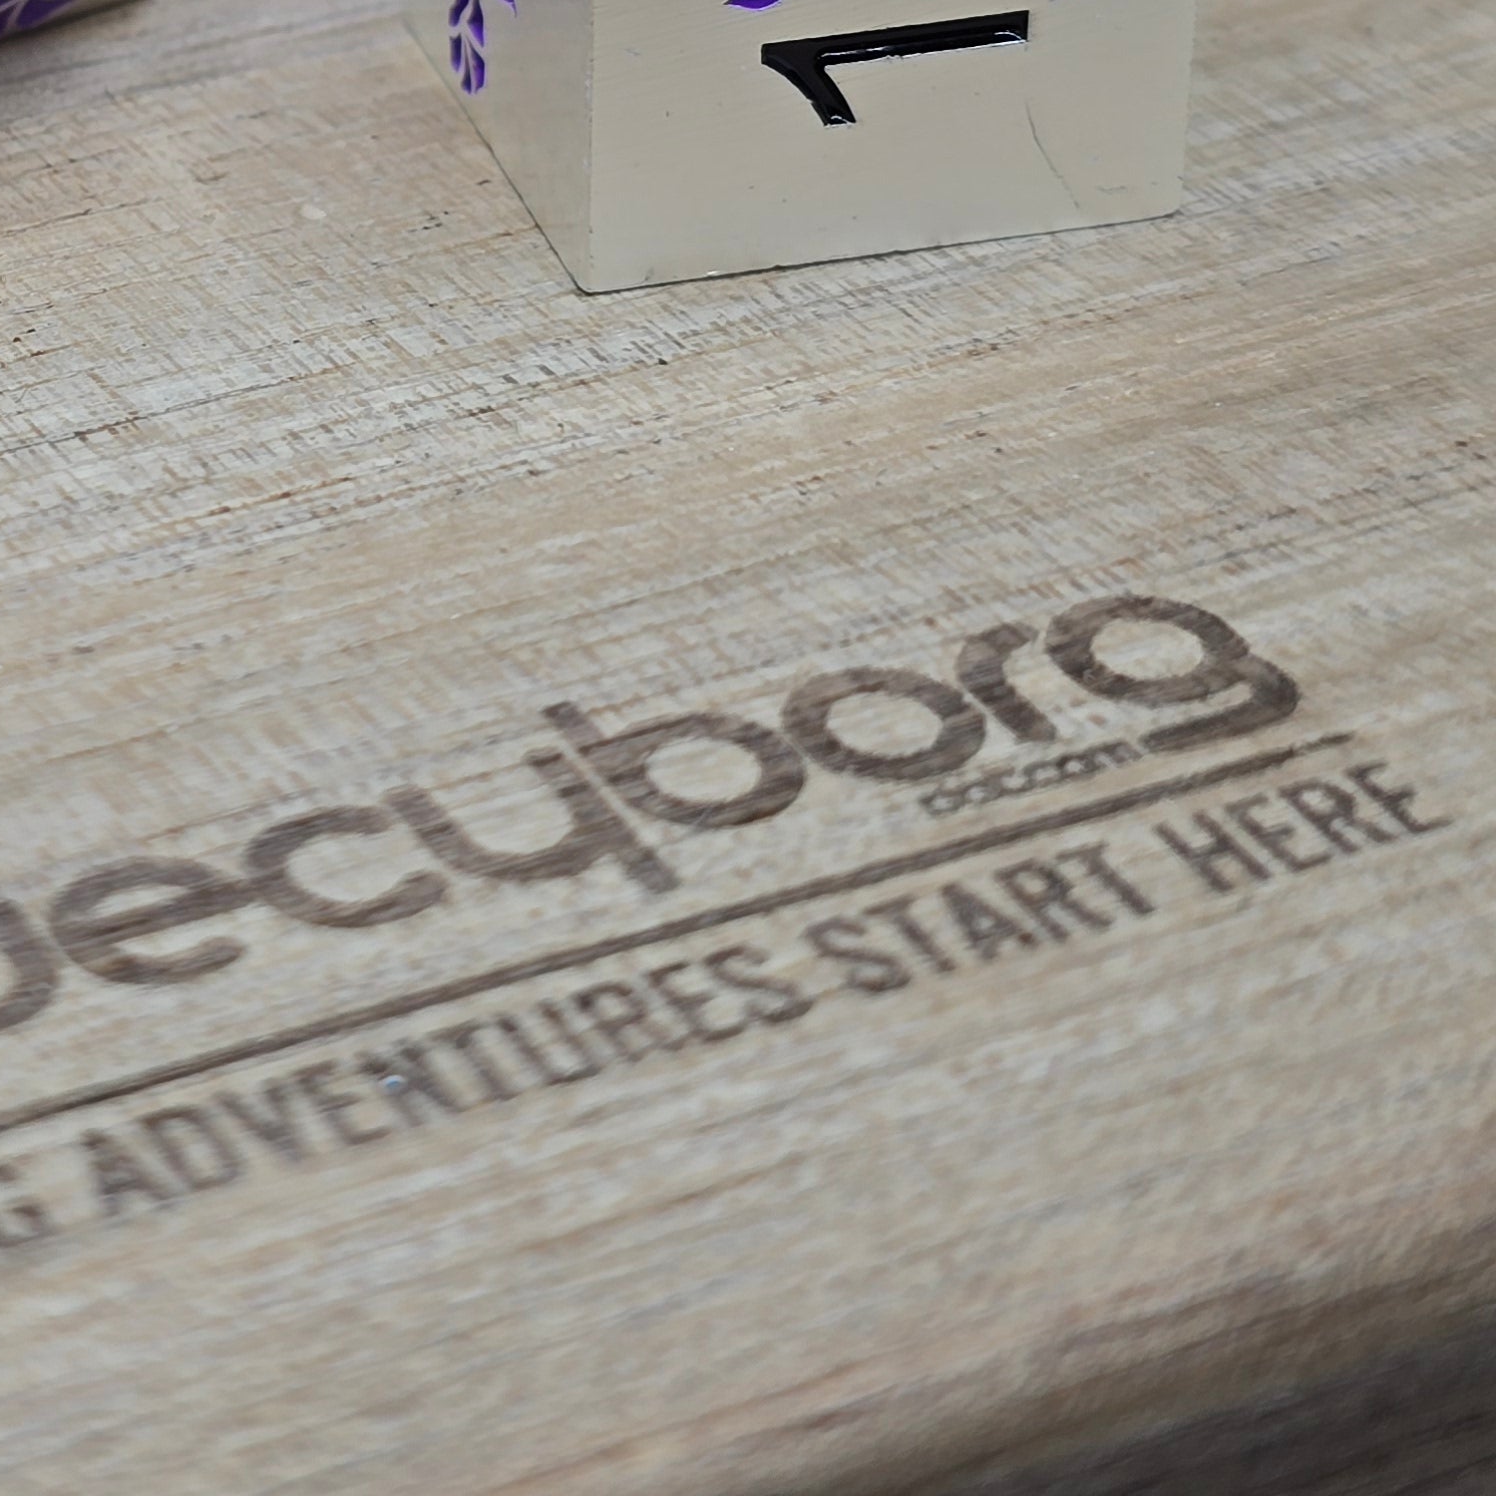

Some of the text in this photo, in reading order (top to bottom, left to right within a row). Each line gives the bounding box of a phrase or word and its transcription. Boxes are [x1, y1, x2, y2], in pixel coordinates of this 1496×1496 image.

[760, 9, 1030, 128] 1
[82, 942, 816, 1218] ADVENTURES
[804, 842, 1158, 994] START
[1154, 759, 1454, 894] HERE
